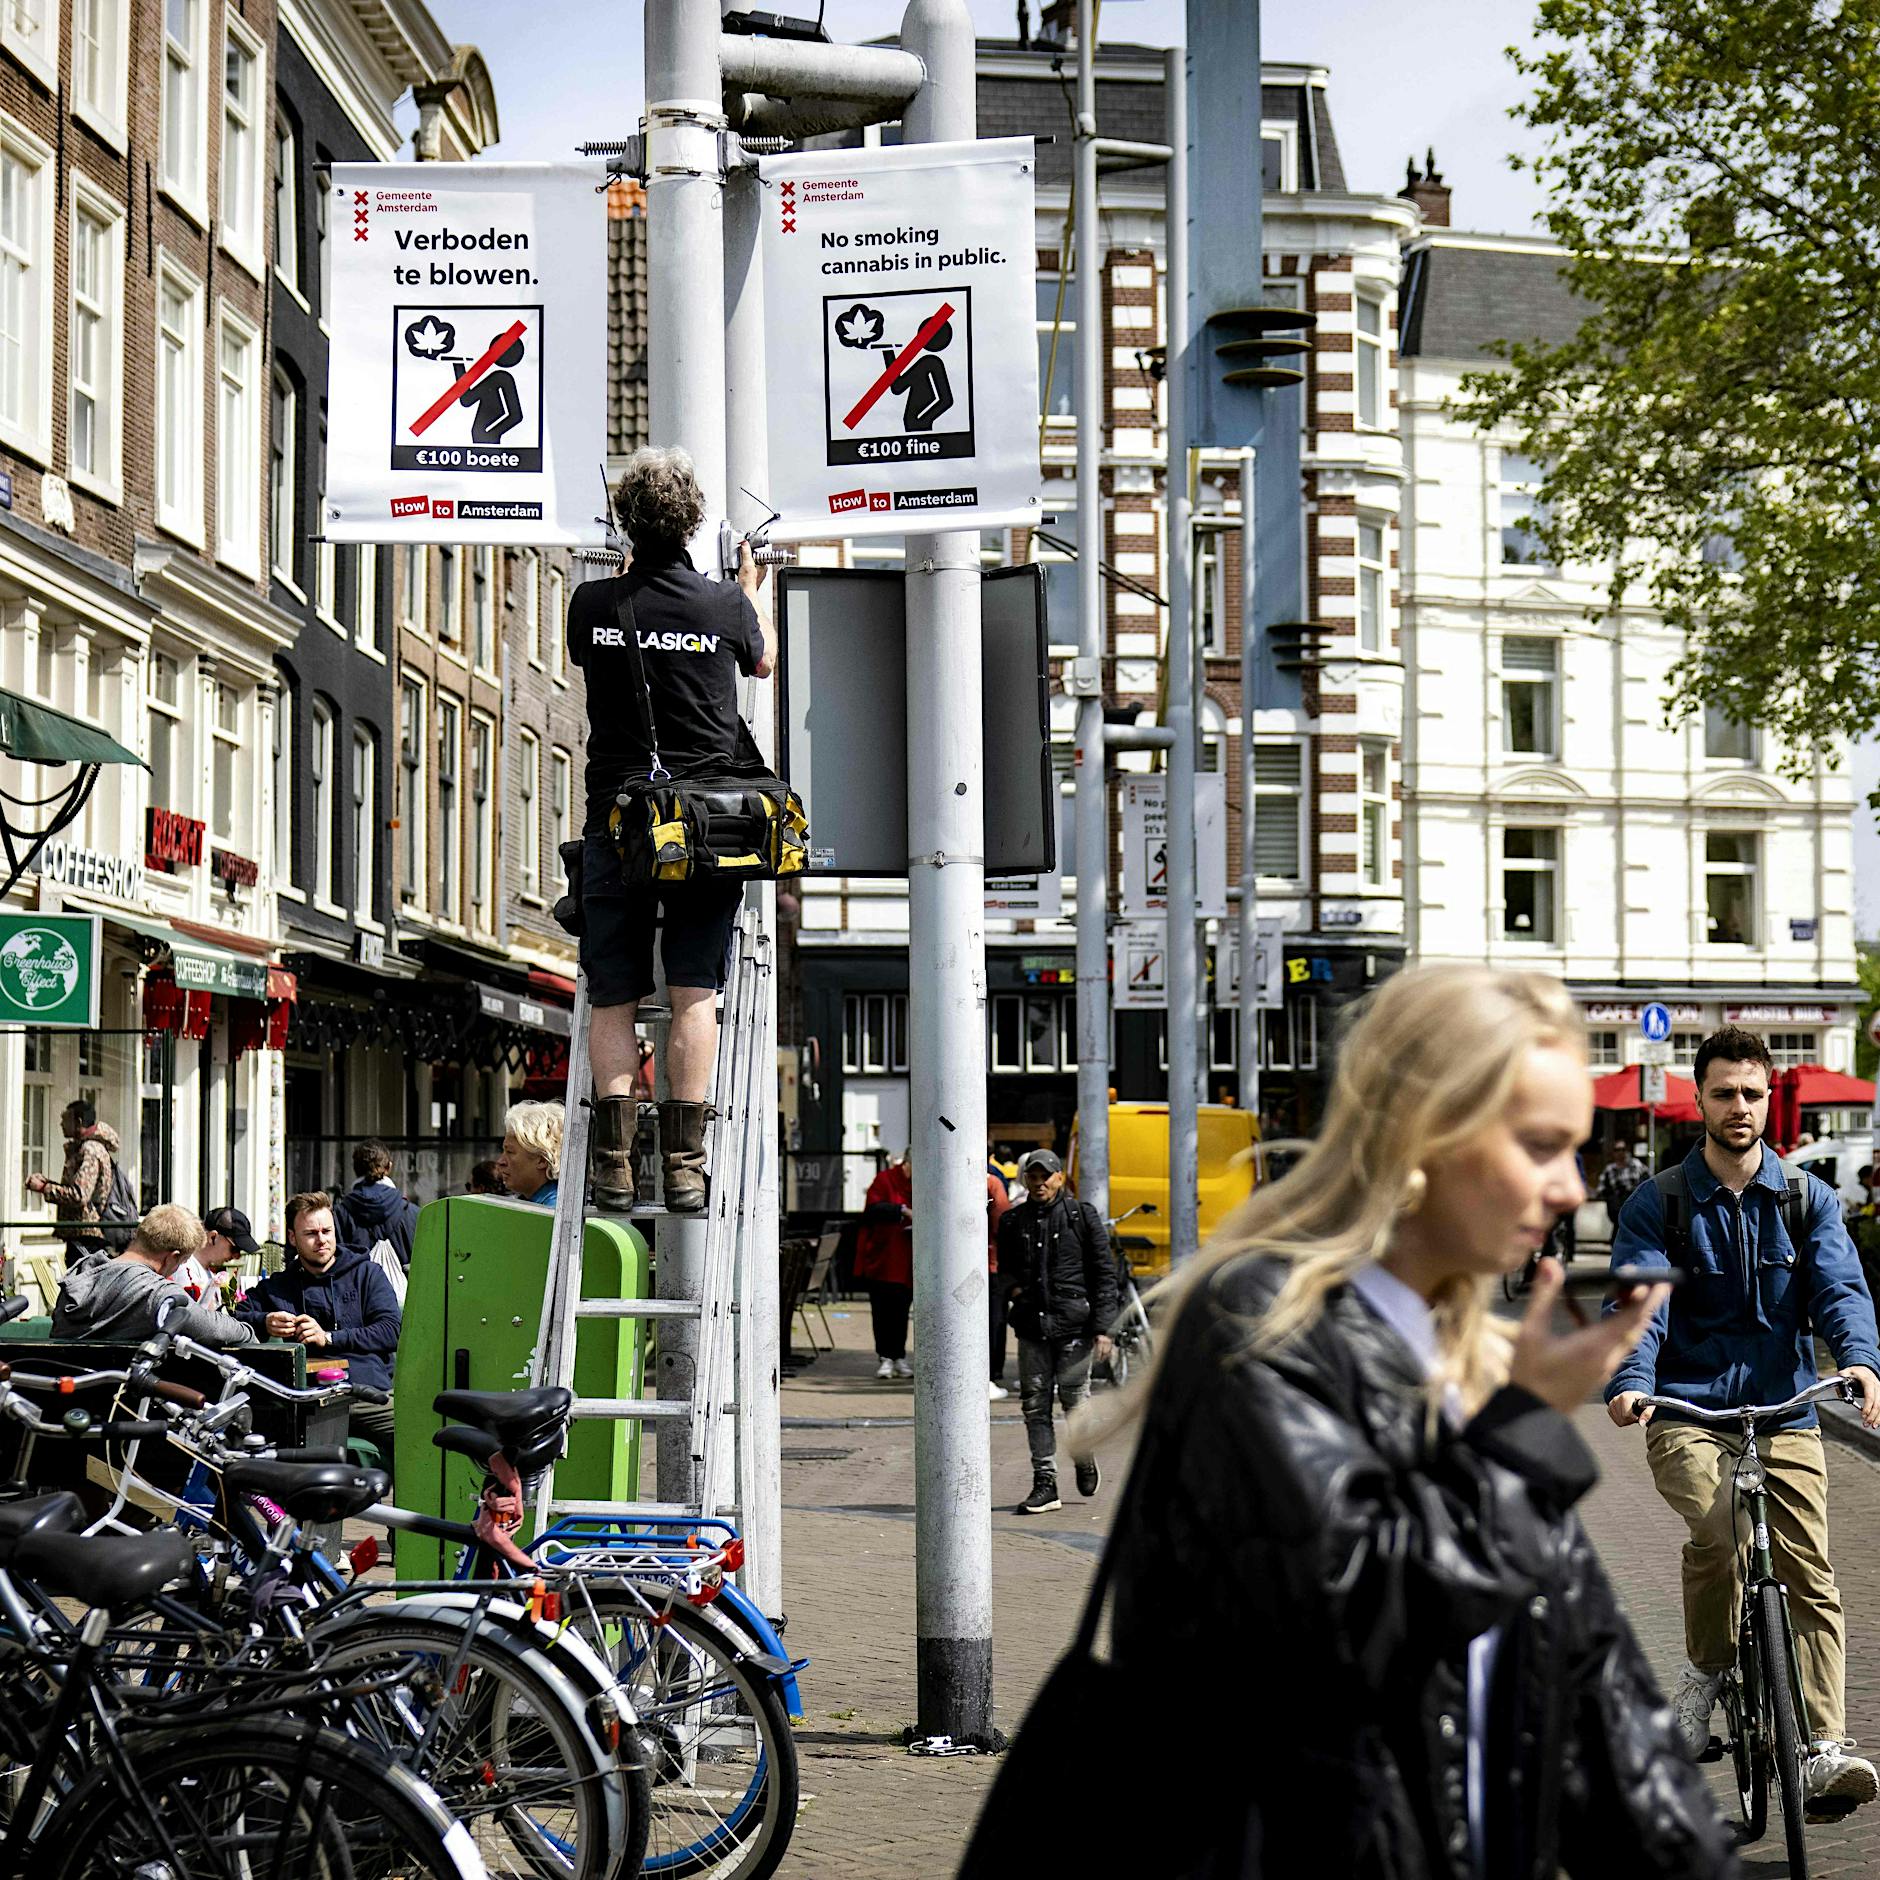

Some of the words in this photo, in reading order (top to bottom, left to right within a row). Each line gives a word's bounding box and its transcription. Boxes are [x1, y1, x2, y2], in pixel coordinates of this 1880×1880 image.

[802, 178, 859, 190] Gemeente
[376, 190, 432, 201] Gemeente
[802, 190, 865, 203] Amsterdam
[376, 203, 438, 213] Amsterdam
[394, 228, 530, 251] Verboden
[821, 231, 849, 249] No
[854, 226, 940, 247] smoking
[821, 253, 909, 275] cannabis
[915, 252, 932, 270] in
[938, 248, 1007, 272] public.
[393, 265, 421, 286] te
[430, 263, 539, 286] blowen.
[415, 449, 461, 466] €100
[467, 449, 520, 467] boete
[857, 442, 902, 458] €100
[906, 438, 940, 456] fine
[394, 500, 425, 515] How
[435, 503, 451, 516] to
[461, 503, 540, 518] Amsterdam
[832, 494, 863, 511] How
[872, 496, 888, 509] to
[897, 491, 975, 508] Amsterdam
[41, 837, 145, 902] COFFEESHOP
[3, 951, 73, 971] Greenhouse
[175, 956, 217, 984] COFFEESHOP
[21, 970, 57, 991] Effect
[392, 1150, 438, 1173] ACOS
